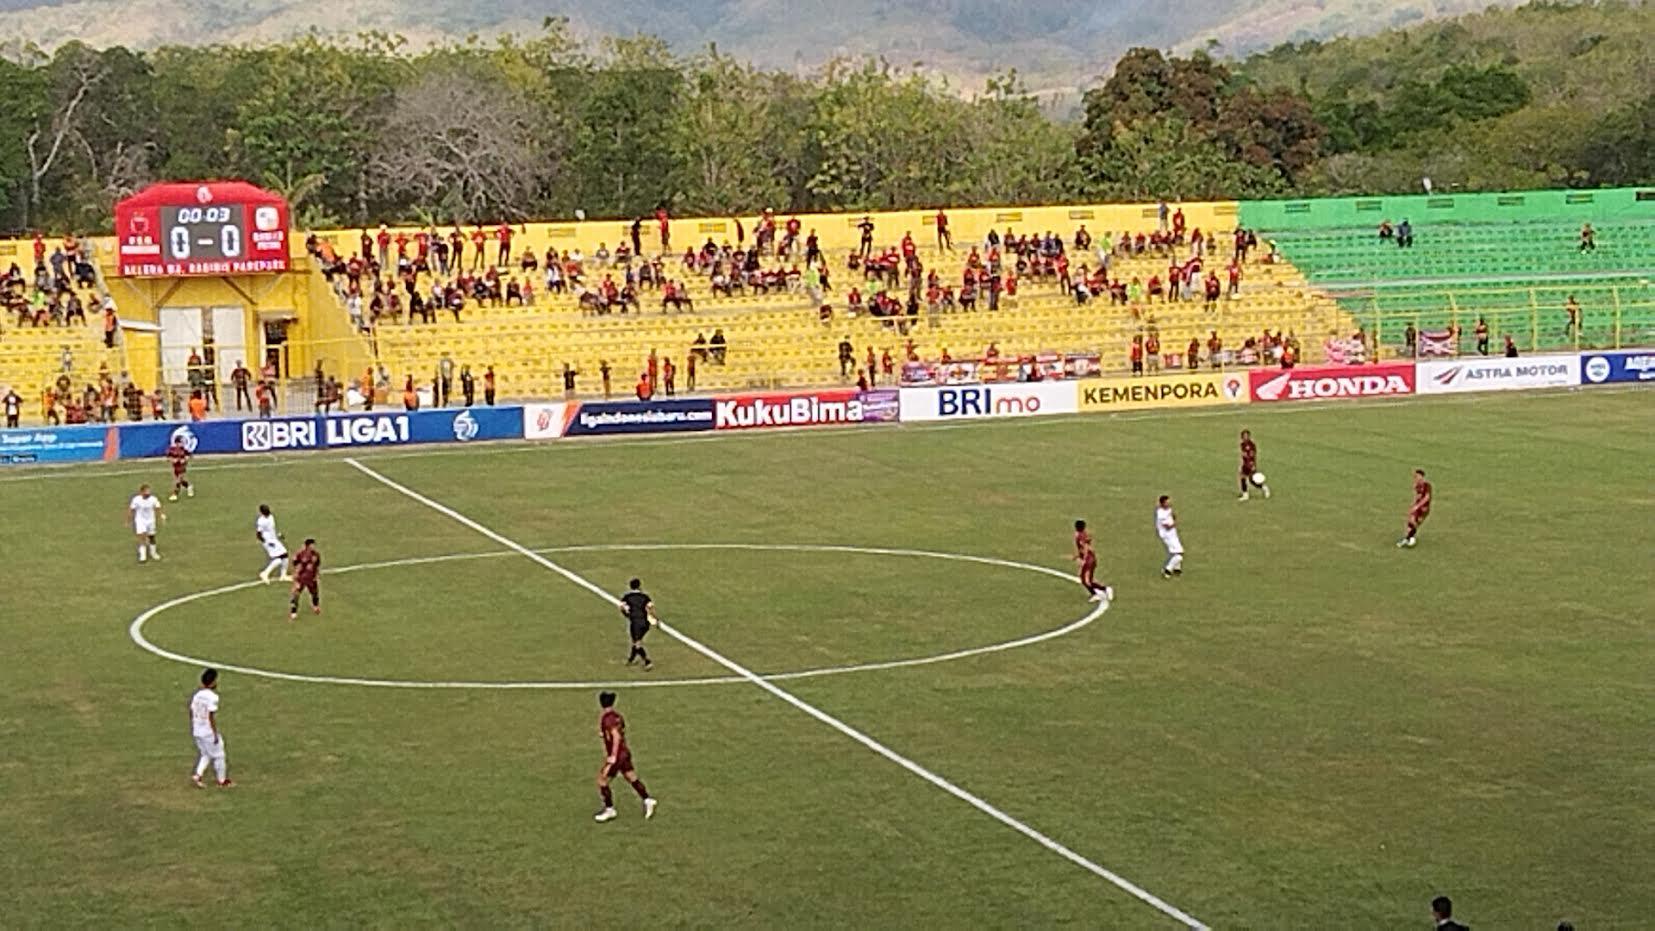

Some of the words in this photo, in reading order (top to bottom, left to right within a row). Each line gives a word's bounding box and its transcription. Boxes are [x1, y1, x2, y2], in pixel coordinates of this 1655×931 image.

[170, 226, 190, 260] 0
[221, 224, 240, 257] 0
[1465, 367, 1512, 379] ASTRA
[1516, 364, 1568, 377] MOTOR
[1083, 382, 1219, 404] KEMENPORA
[1288, 375, 1411, 398] HONDA
[716, 396, 864, 428] KukuBima
[271, 420, 316, 448] BRI
